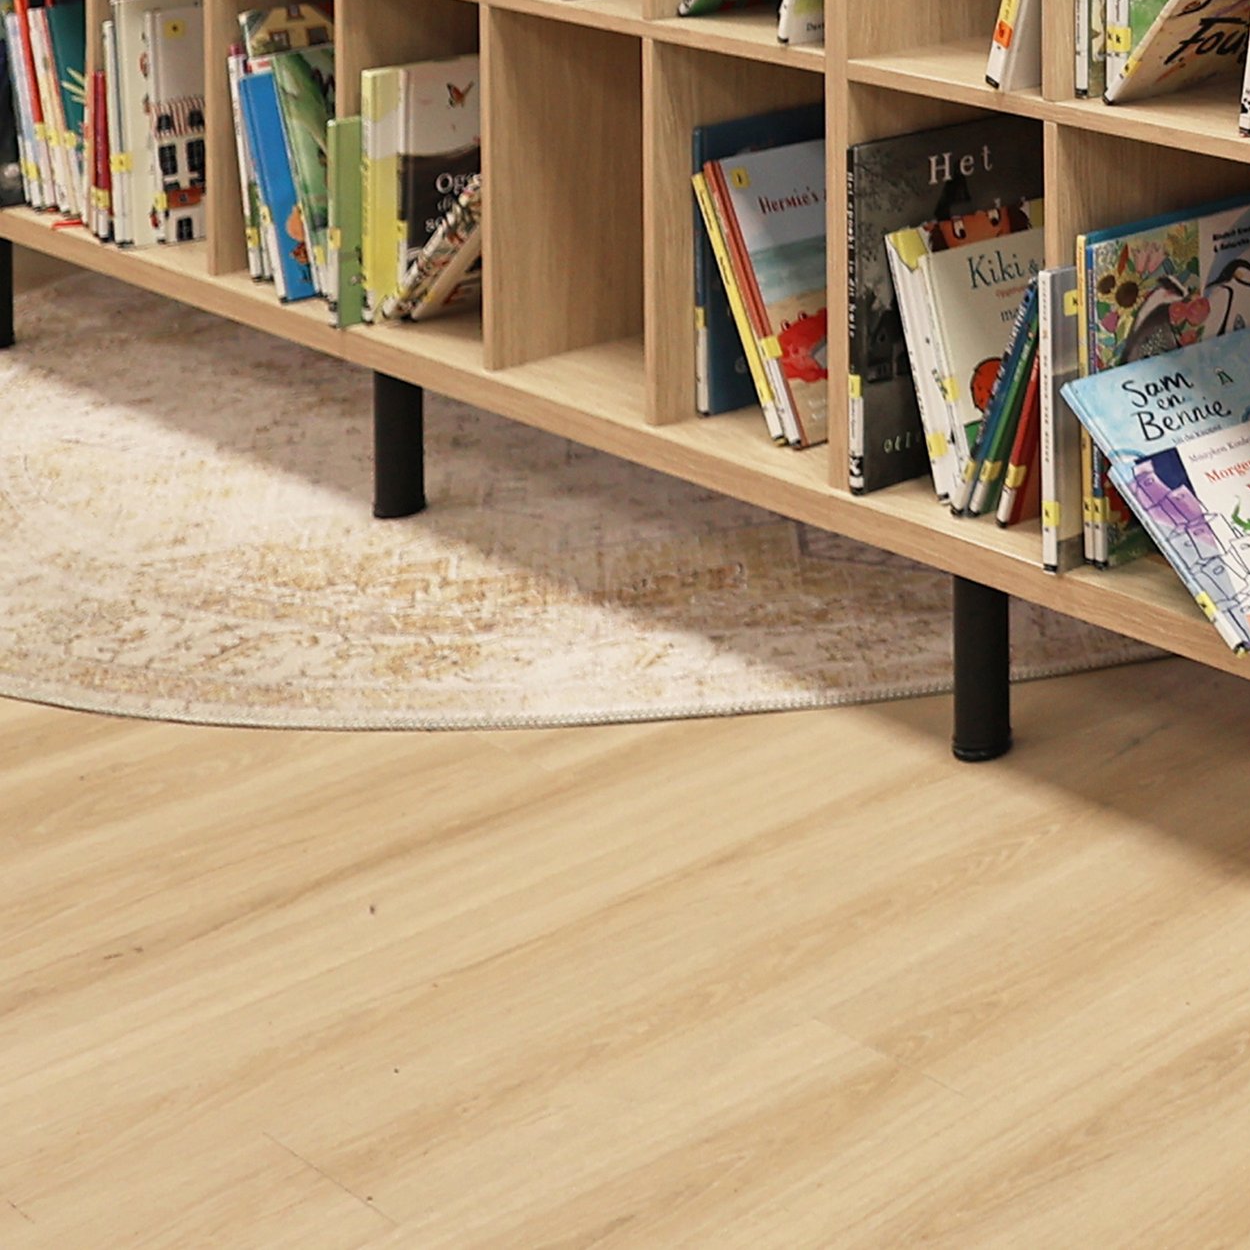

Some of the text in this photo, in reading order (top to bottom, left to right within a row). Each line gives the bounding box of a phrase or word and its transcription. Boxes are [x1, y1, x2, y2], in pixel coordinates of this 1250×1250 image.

[1164, 17, 1250, 64] Fou
[928, 145, 992, 185] Het
[968, 250, 1024, 290] Kiki
[1122, 370, 1194, 408] Sam
[1156, 391, 1186, 410] en
[1131, 396, 1232, 442] Bennie
